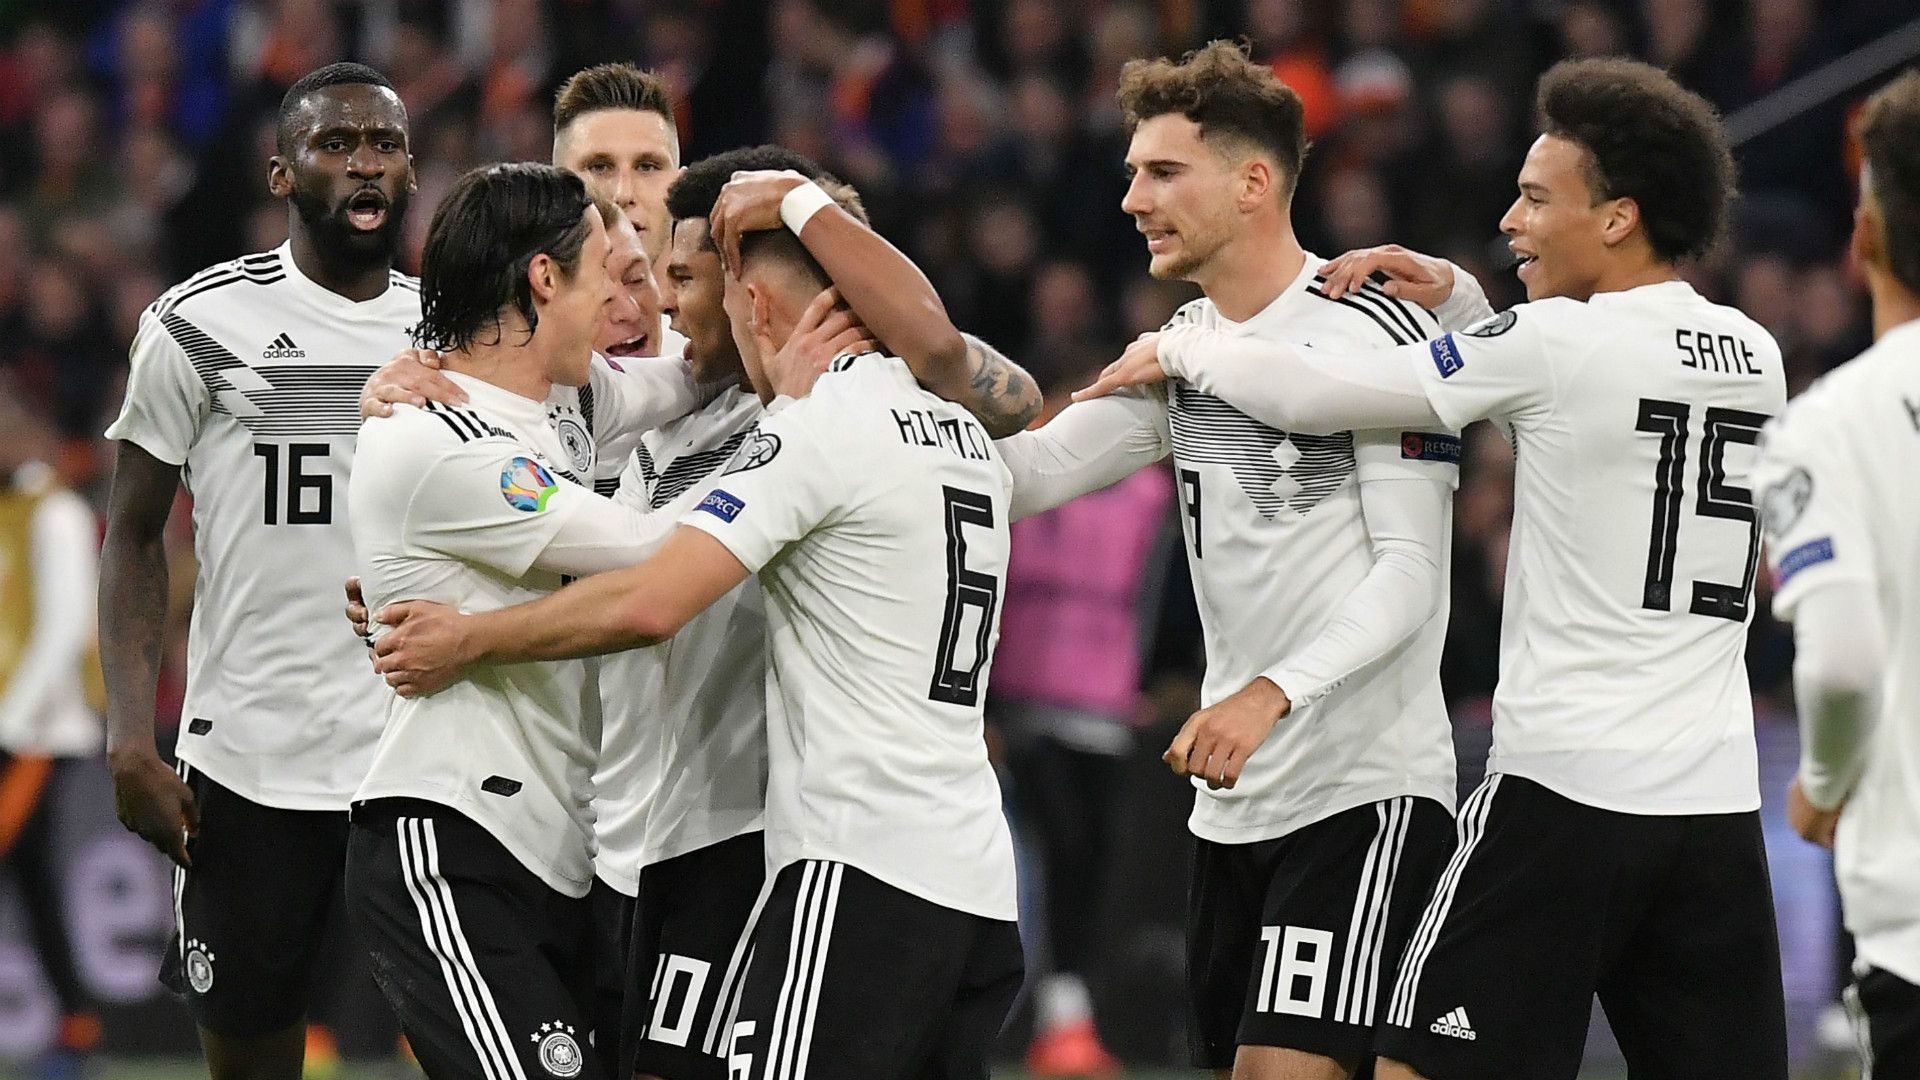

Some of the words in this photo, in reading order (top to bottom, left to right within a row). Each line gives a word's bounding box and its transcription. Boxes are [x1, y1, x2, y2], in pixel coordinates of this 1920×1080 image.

[263, 348, 305, 359] adidas
[254, 443, 332, 525] 16
[1635, 398, 1774, 623] 15
[928, 485, 998, 707] 6
[1256, 925, 1334, 1019] 18
[1430, 1023, 1477, 1041] adidas
